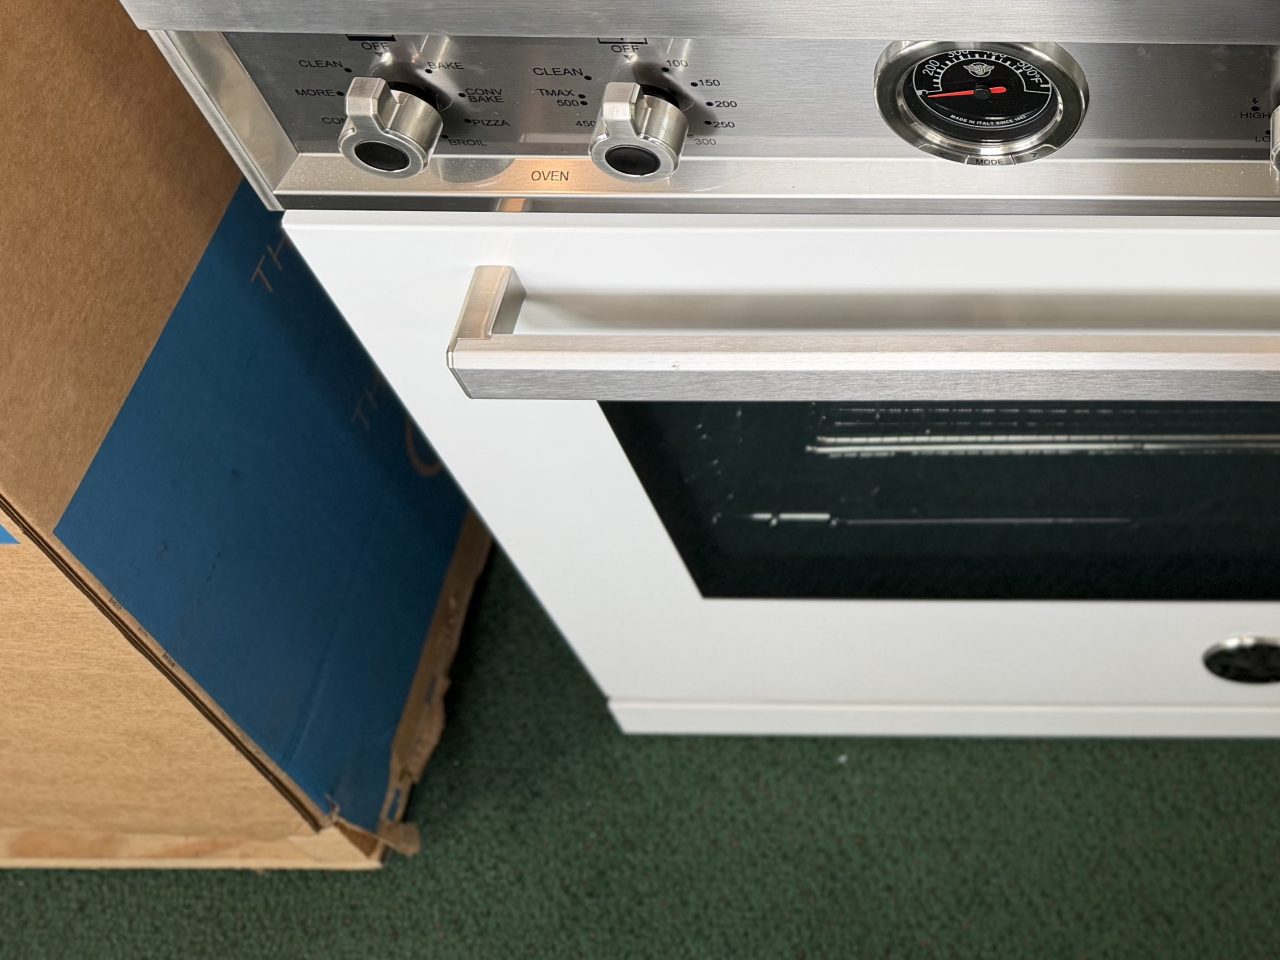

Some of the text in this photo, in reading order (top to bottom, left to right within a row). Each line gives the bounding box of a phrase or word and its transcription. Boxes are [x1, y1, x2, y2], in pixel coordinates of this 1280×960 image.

[361, 41, 389, 50] OFF
[611, 44, 639, 53] OFF
[298, 59, 344, 68] CLEAN
[427, 61, 465, 70] BAKE
[665, 59, 689, 68] 100
[922, 60, 940, 76] 200
[532, 67, 584, 76] CLEAN
[698, 79, 721, 87] 150
[294, 88, 336, 97] MORE
[465, 87, 503, 96] CONV
[536, 88, 576, 97] TMAX
[468, 95, 505, 103] BAKE
[557, 99, 579, 107] 500
[714, 100, 738, 108] 200
[473, 119, 512, 127] PIZZA
[950, 114, 968, 123] MADE
[576, 120, 597, 128] 450
[712, 121, 736, 129] 250
[448, 139, 489, 147] BROIL
[695, 138, 717, 146] 300
[531, 170, 570, 181] OVEN
